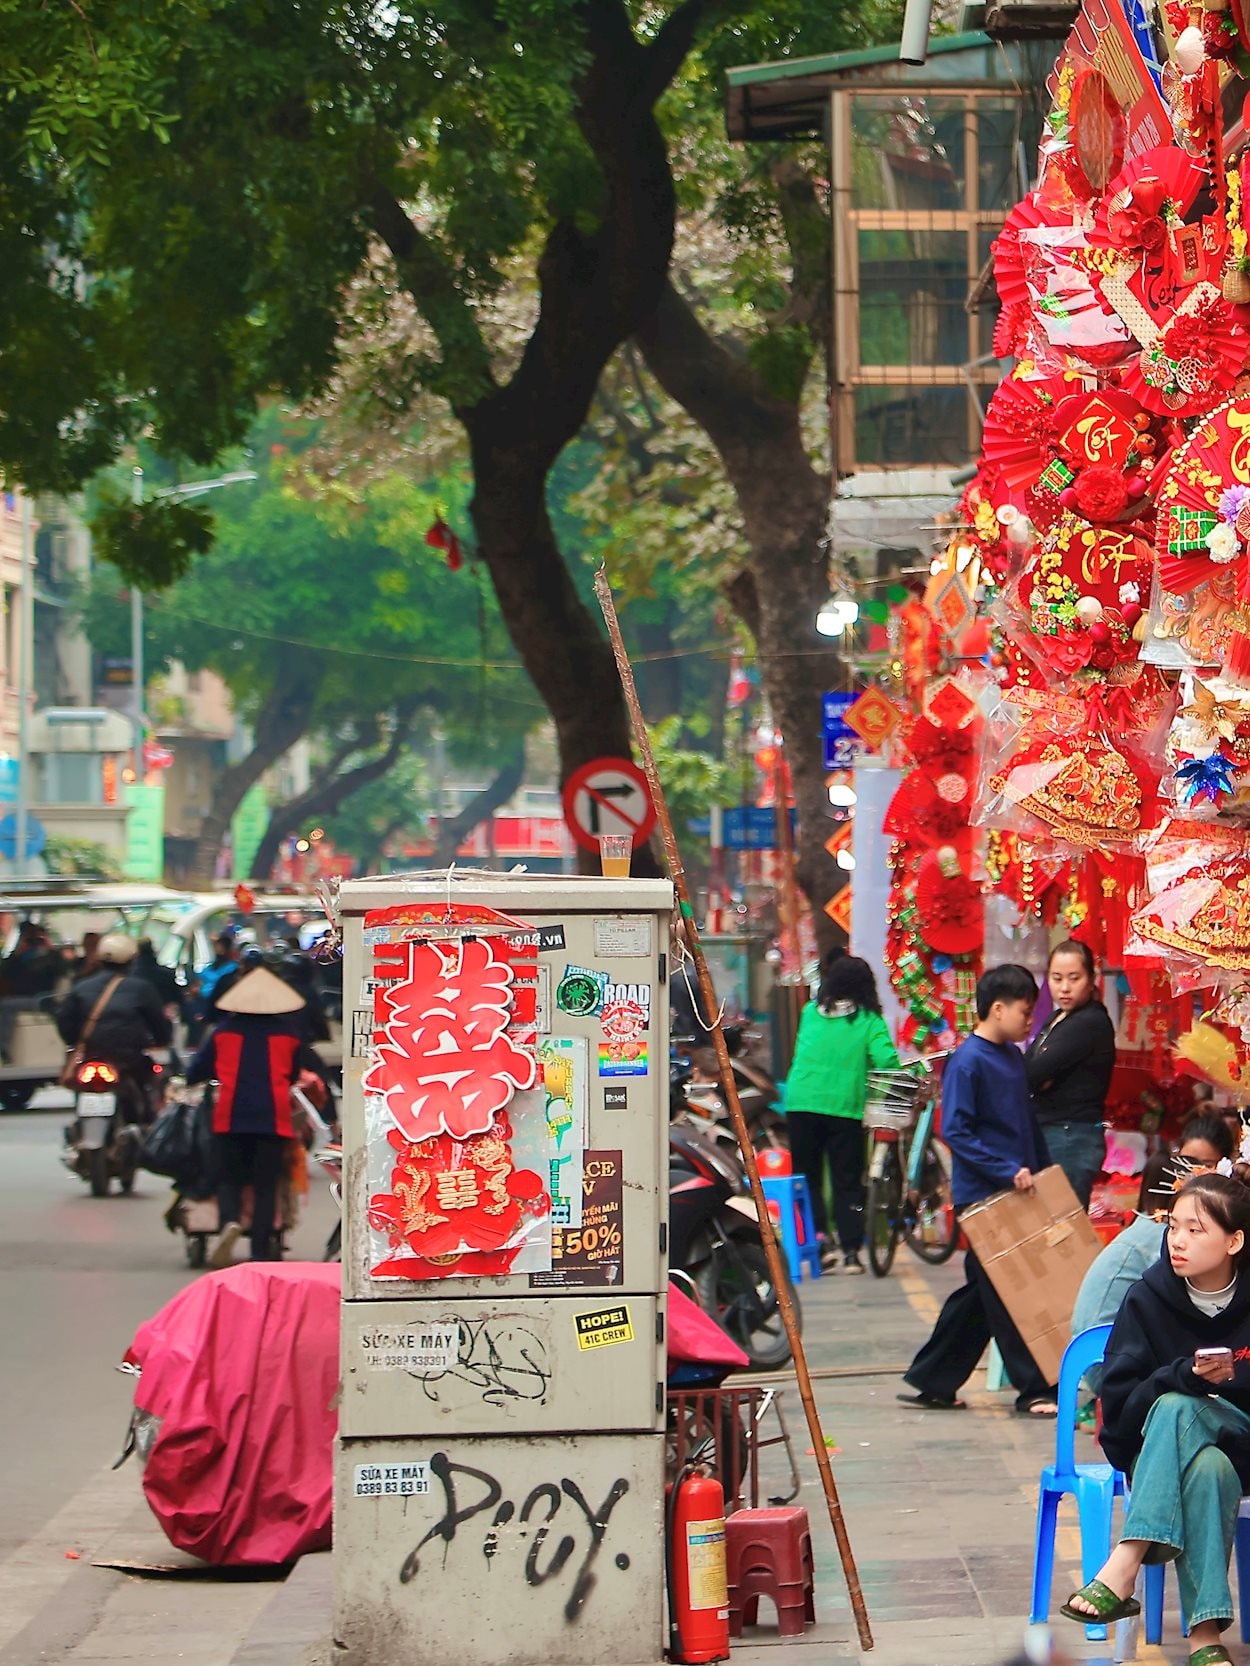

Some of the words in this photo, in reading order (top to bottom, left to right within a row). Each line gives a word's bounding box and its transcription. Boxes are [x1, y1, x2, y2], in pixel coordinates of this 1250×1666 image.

[604, 983, 650, 1005] ROAD
[583, 1161, 617, 1179] CE
[565, 1222, 621, 1255] 50%
[603, 1246, 621, 1257] HÁT
[580, 1310, 625, 1330] HOPE!
[397, 1334, 415, 1349] XE
[421, 1332, 452, 1349] MÁY
[602, 1328, 626, 1341] CREW
[361, 1465, 382, 1481] SỬA
[385, 1468, 398, 1480] XE
[401, 1465, 425, 1479] MÁY
[356, 1482, 382, 1495] 0389
[385, 1482, 398, 1493] 83
[401, 1481, 413, 1493] 83
[416, 1481, 428, 1492] 91
